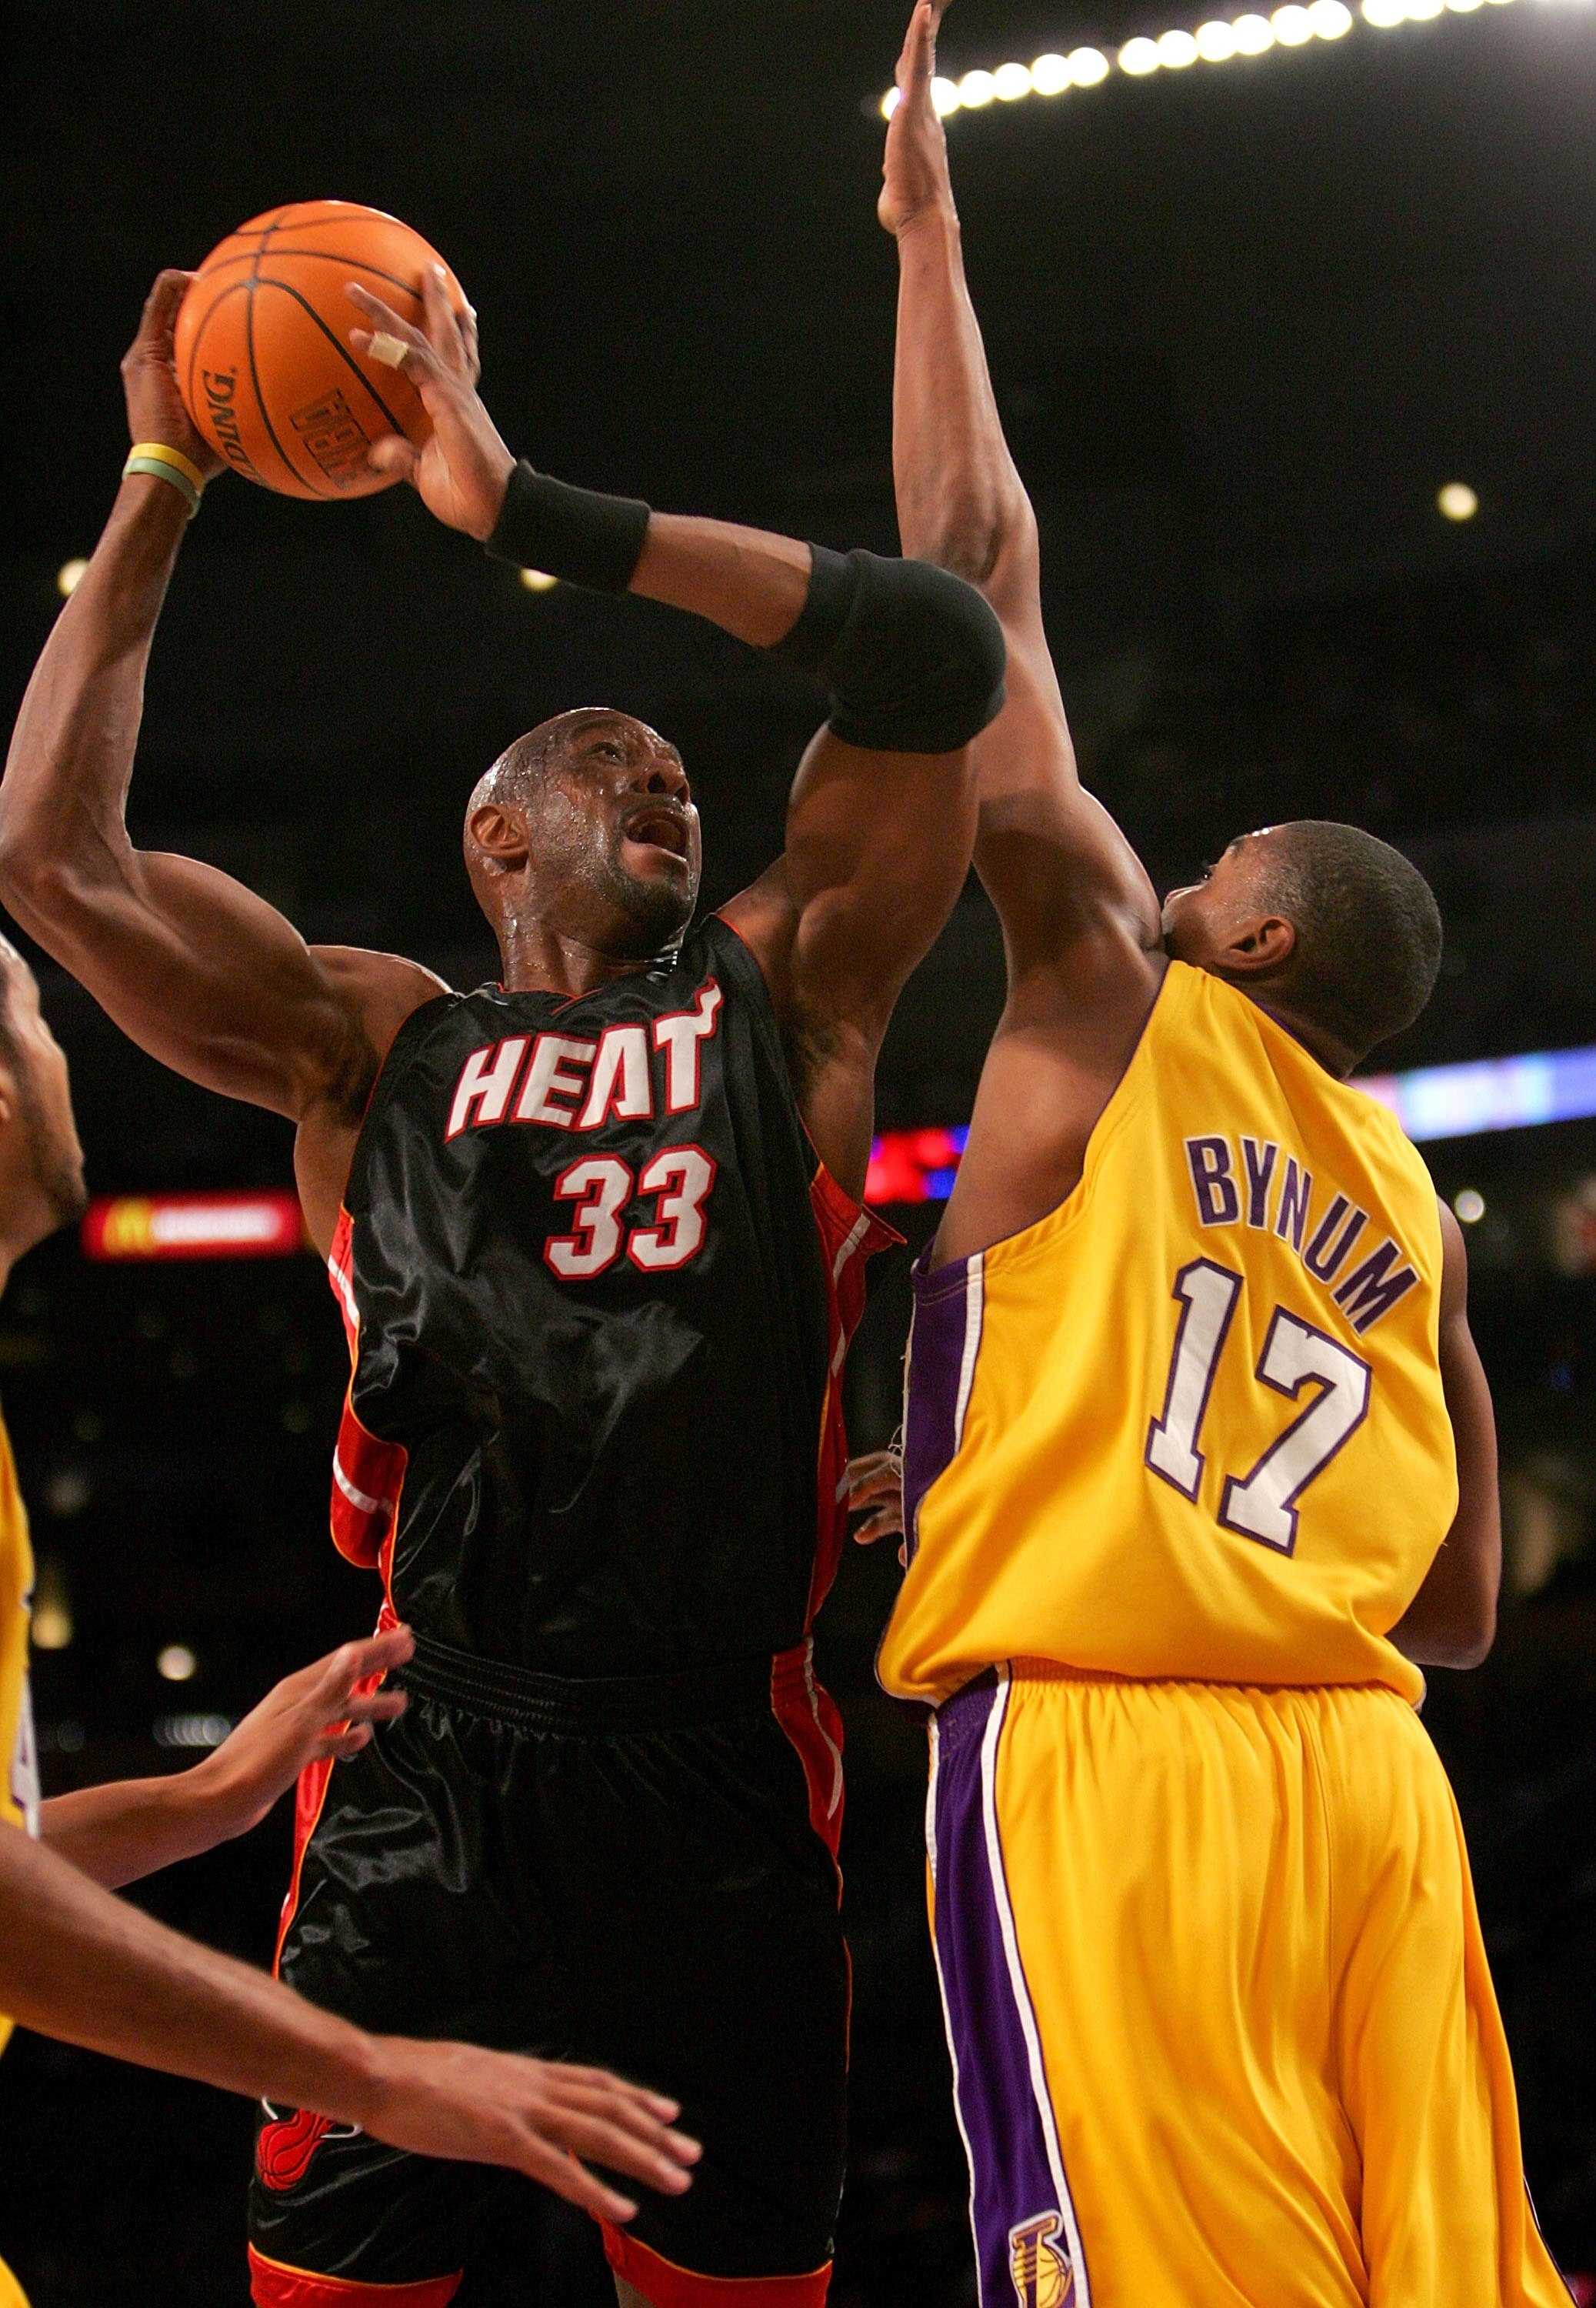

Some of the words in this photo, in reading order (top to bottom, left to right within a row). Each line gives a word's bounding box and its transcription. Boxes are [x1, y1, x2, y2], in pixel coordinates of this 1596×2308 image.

[445, 975, 724, 1143] HEAT
[543, 1143, 718, 1281] 33
[1183, 1134, 1421, 1338] BYNUM
[1145, 1256, 1372, 1558] 17
